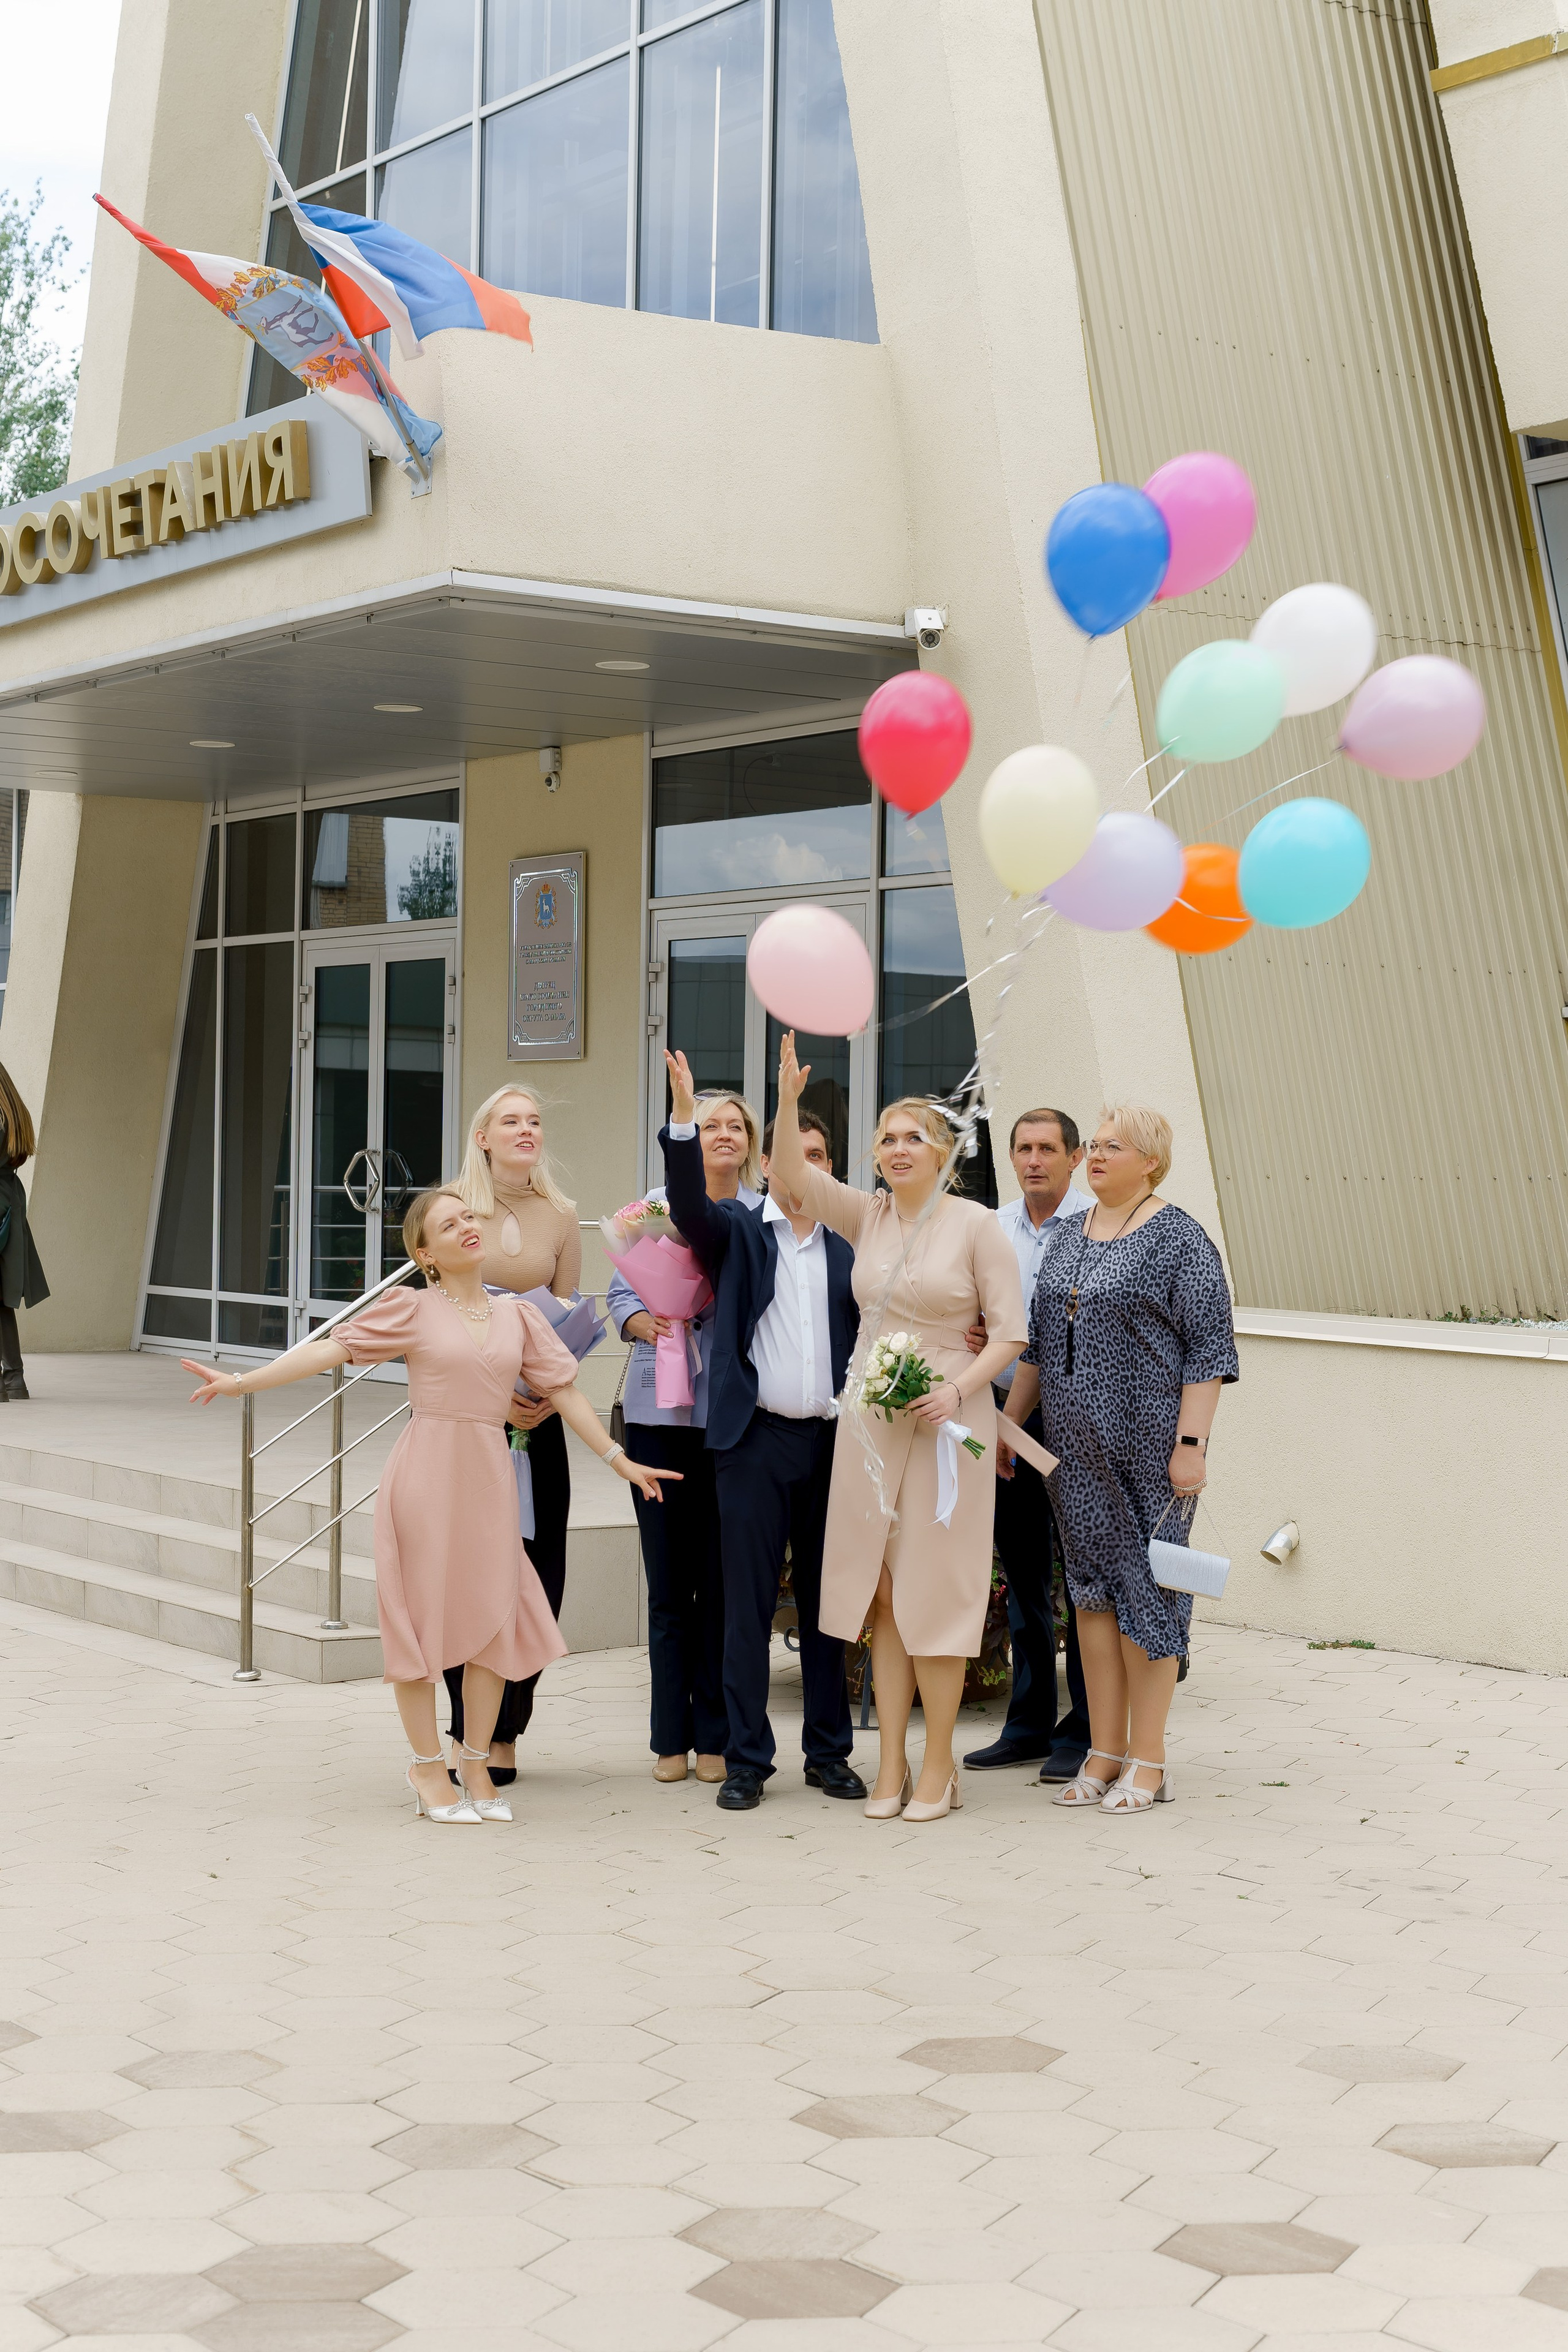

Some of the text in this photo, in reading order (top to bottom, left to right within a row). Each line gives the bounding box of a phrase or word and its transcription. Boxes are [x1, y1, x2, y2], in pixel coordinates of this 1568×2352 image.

[533, 981, 556, 991] ДВОРЕЦ
[519, 990, 570, 1001] БРАКОСОЧЕТАНИЯ
[527, 1002, 562, 1012] ГОРОДСКОГО
[522, 1012, 566, 1023] ОКРУГА САМАРА
